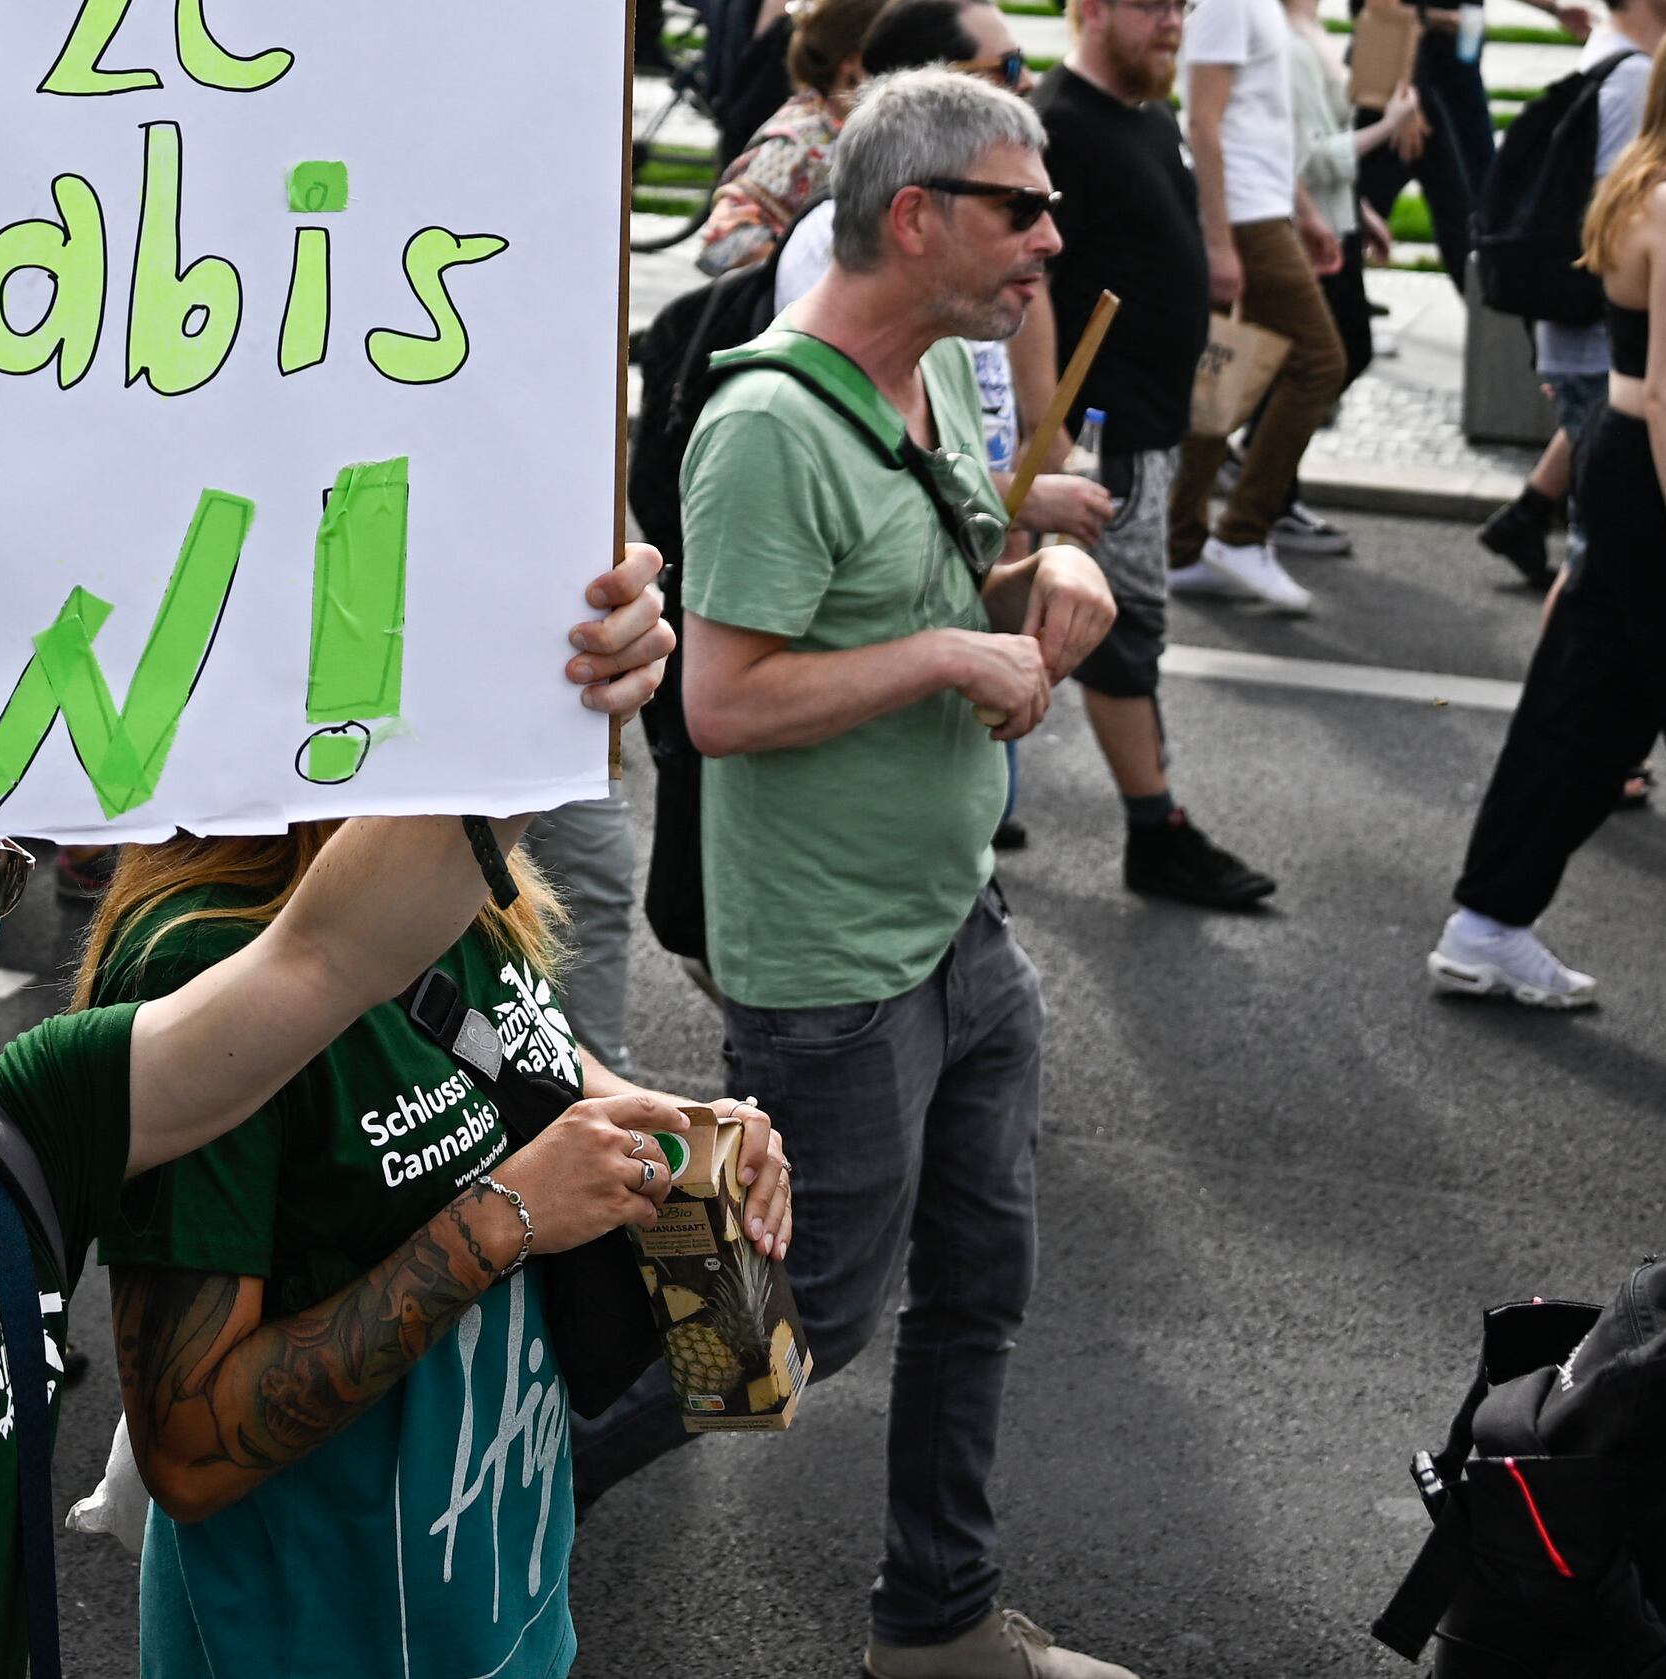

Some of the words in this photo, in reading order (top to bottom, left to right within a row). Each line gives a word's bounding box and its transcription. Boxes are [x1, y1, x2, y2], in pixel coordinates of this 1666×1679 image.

[361, 1074, 467, 1147] Schluss
[381, 1101, 495, 1188] Cannabis
[643, 1223, 707, 1233] ANASSAFT
